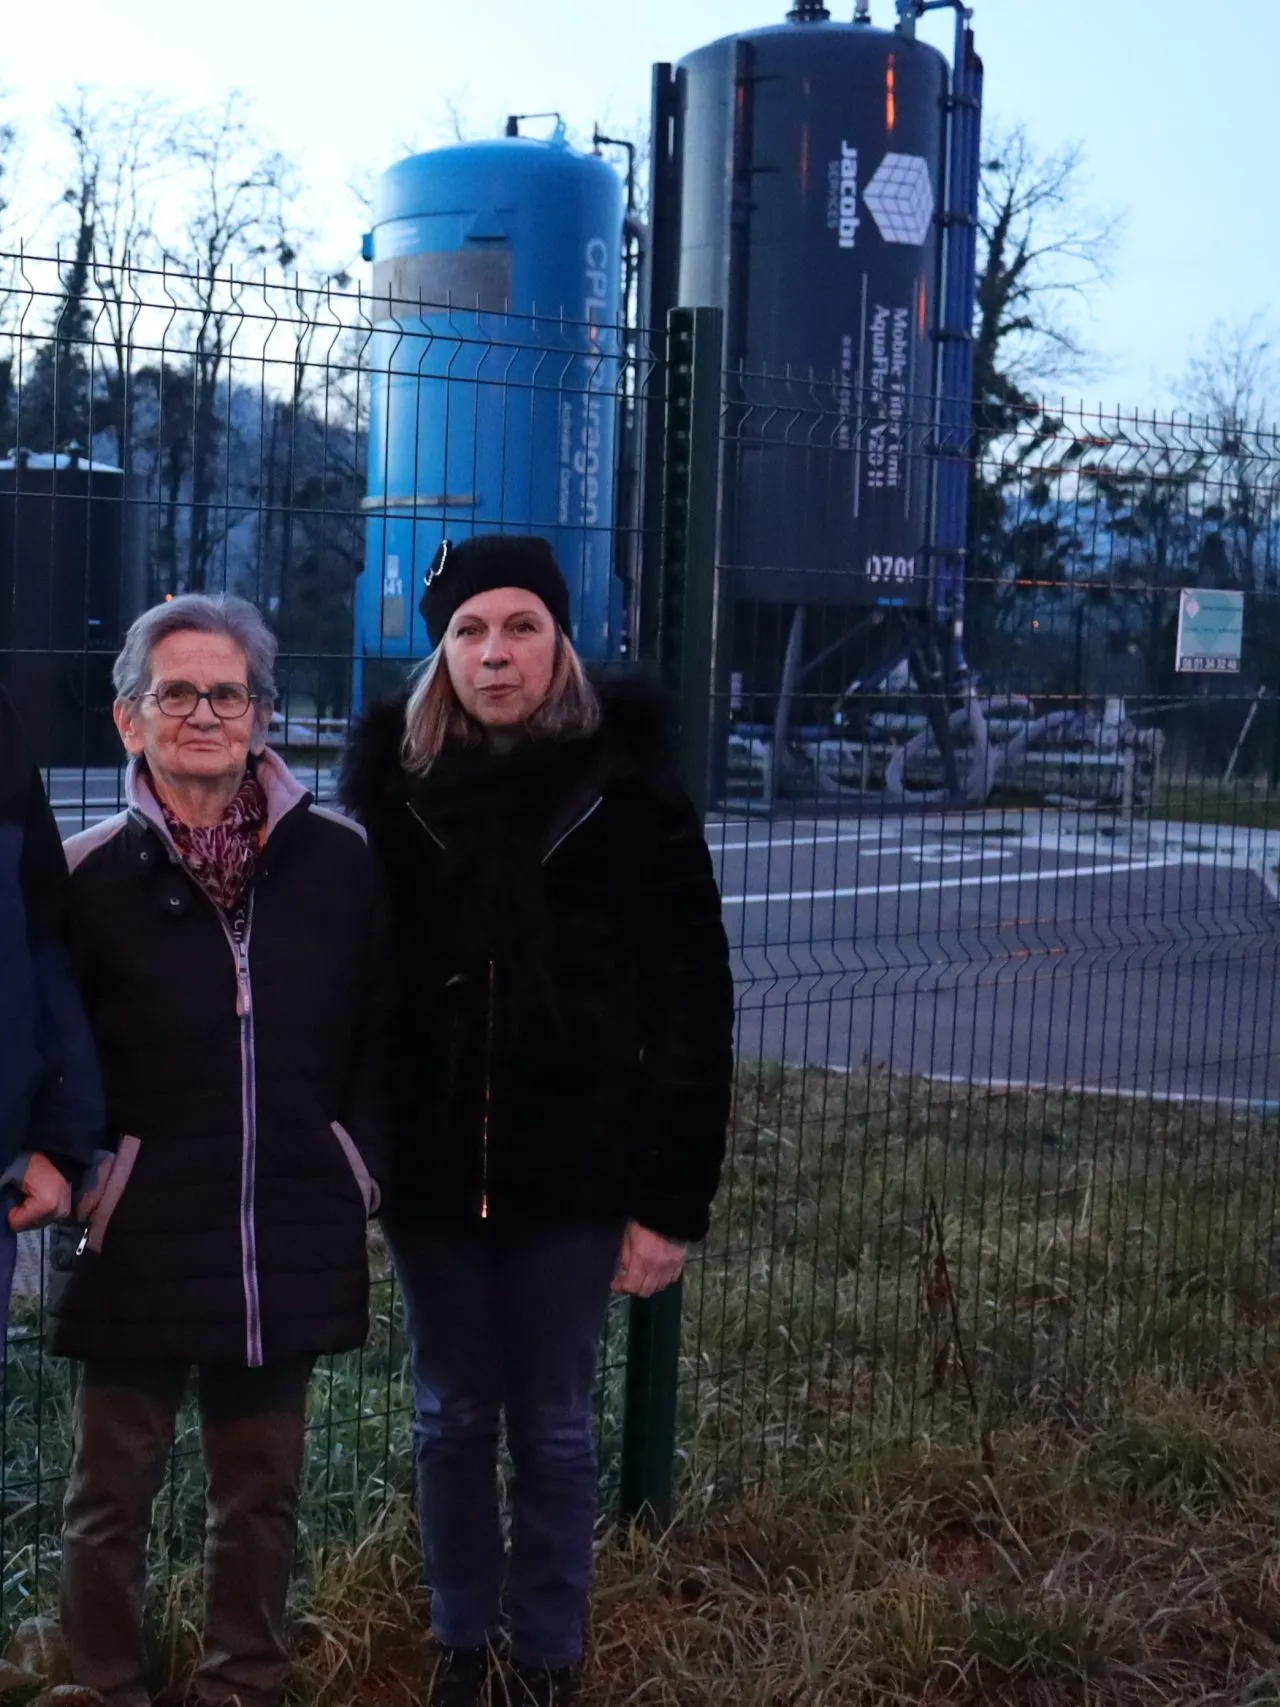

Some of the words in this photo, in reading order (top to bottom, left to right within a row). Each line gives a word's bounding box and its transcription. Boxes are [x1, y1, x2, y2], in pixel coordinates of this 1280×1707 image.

[838, 139, 861, 248] Jacobi
[890, 307, 909, 376] Mobile
[866, 554, 915, 583] 0701
